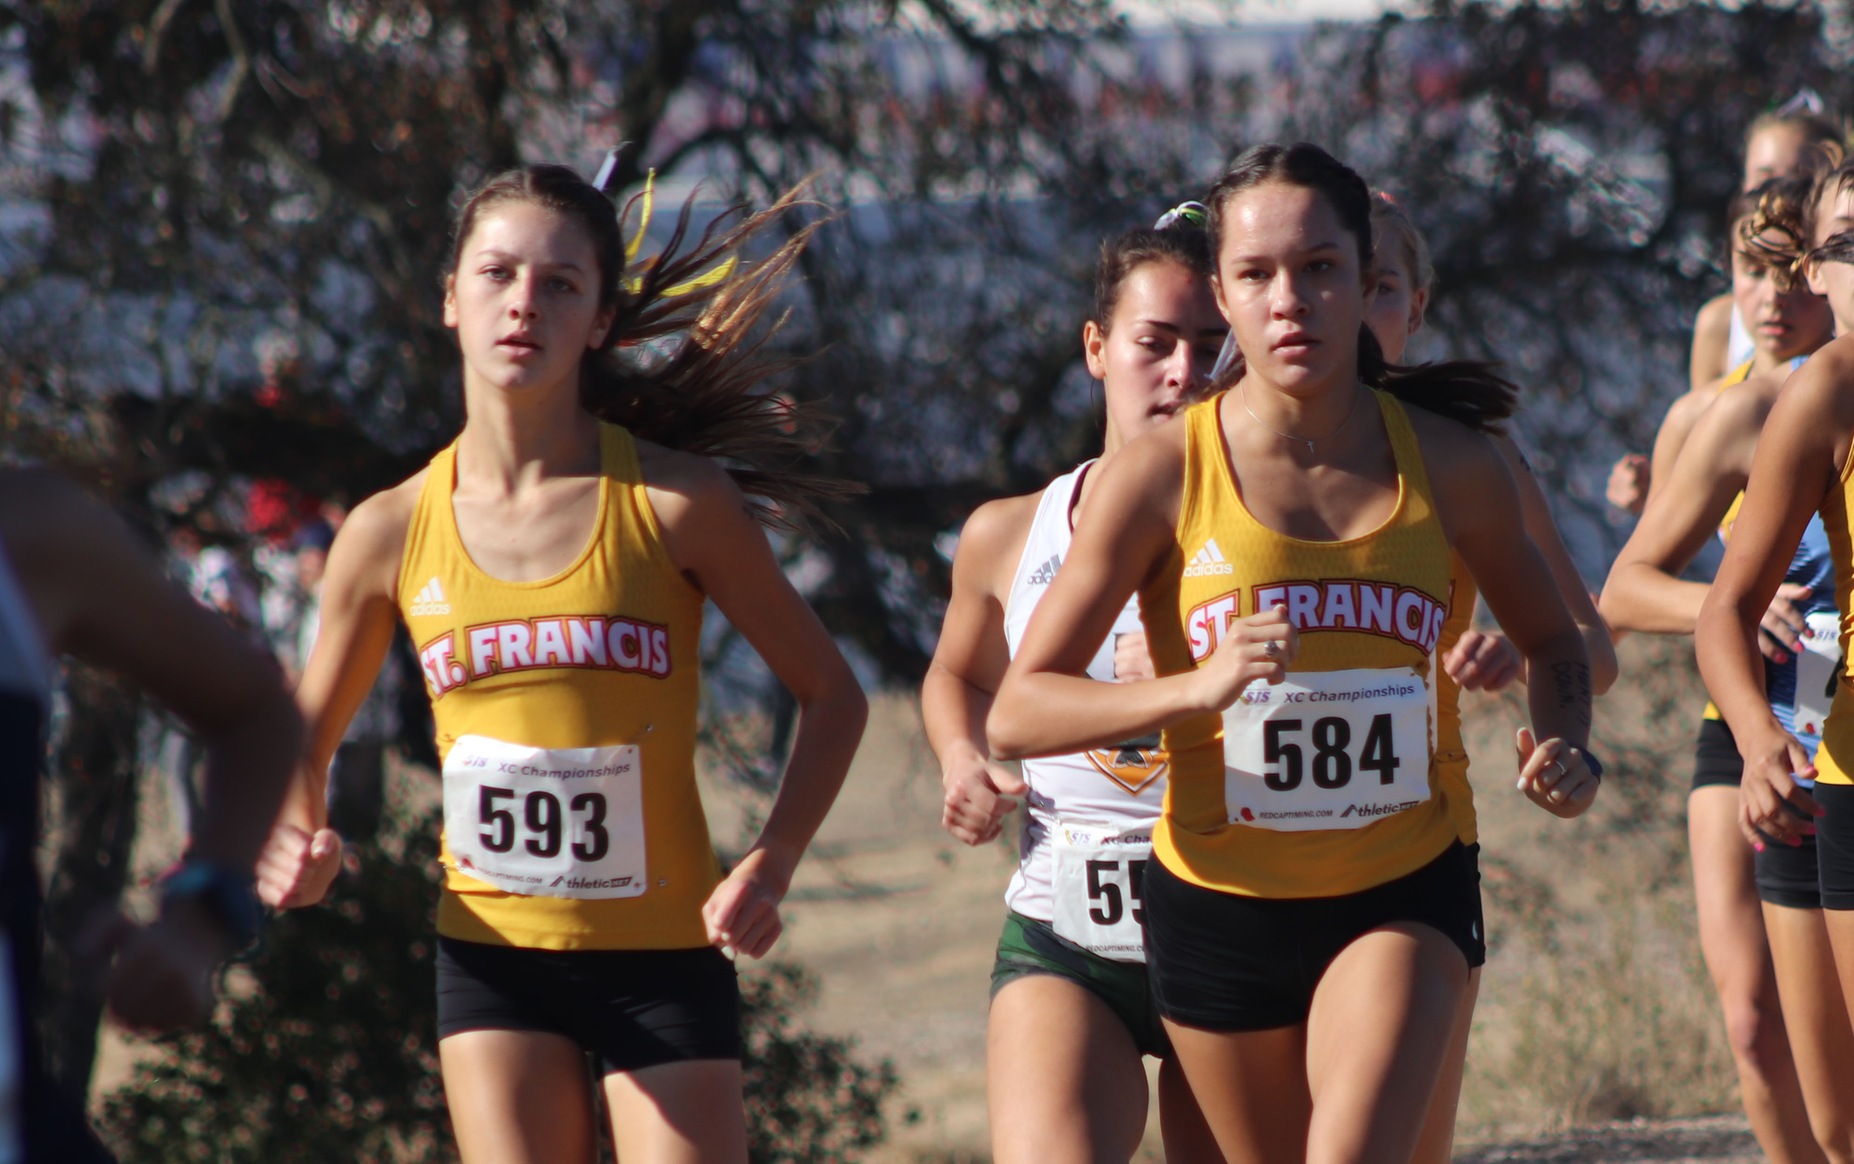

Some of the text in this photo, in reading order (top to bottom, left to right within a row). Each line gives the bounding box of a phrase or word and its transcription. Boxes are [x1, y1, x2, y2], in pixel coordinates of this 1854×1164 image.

[1184, 563, 1233, 577] adidas
[410, 601, 450, 616] adidas
[1186, 589, 1241, 666] ST
[465, 615, 672, 679] FRANCIS
[1284, 692, 1306, 703] XC
[1309, 684, 1415, 702] Championships
[1263, 713, 1401, 792] 584
[497, 762, 518, 775] XC
[521, 763, 631, 781] Championships
[478, 784, 610, 863] 593
[1124, 834, 1151, 844] Cha
